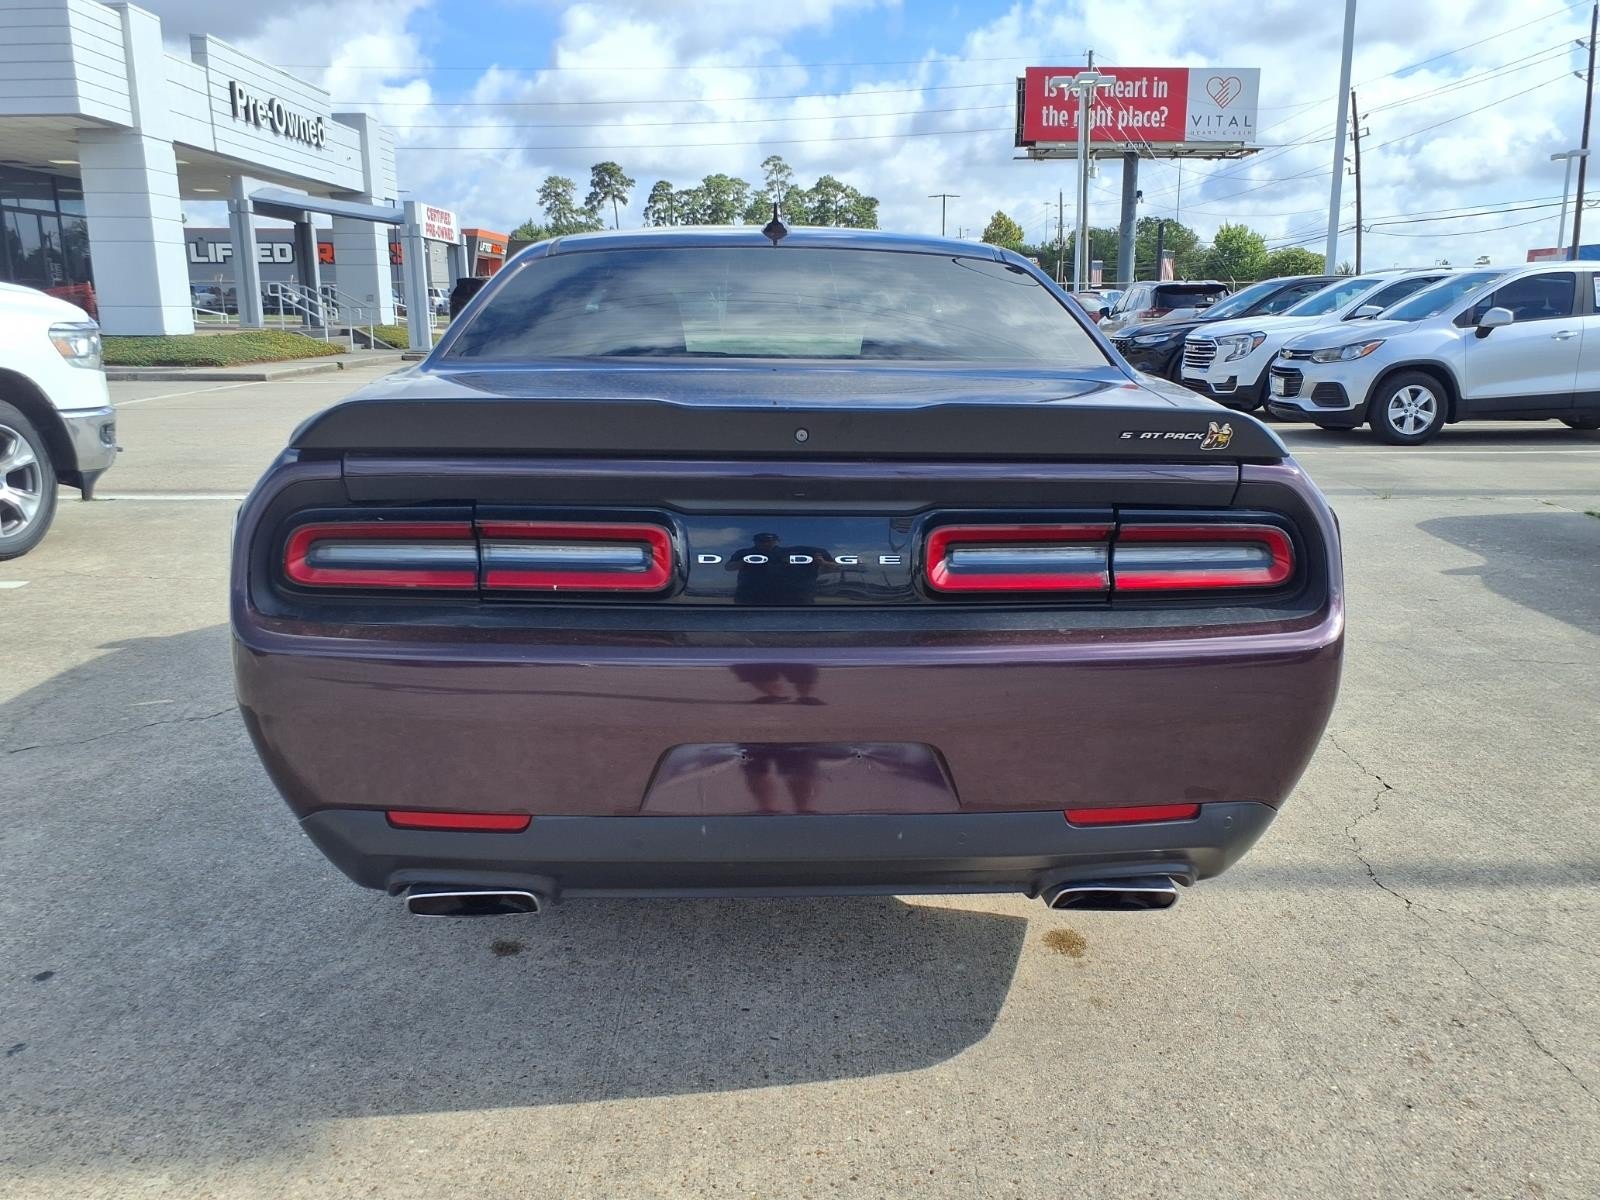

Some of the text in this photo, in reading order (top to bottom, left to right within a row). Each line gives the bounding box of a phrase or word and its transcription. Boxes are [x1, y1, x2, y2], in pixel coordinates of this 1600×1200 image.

[1153, 76, 1168, 98] in
[229, 80, 326, 151] Pre-Owned
[1042, 105, 1069, 127] the
[1118, 105, 1169, 130] place?
[1191, 115, 1252, 127] VITAL
[426, 206, 452, 226] CERTIFIED
[425, 222, 455, 242] PRE-OWNED
[188, 242, 294, 264] LIFED
[1163, 432, 1205, 440] PACK
[698, 554, 901, 565] DODGE
